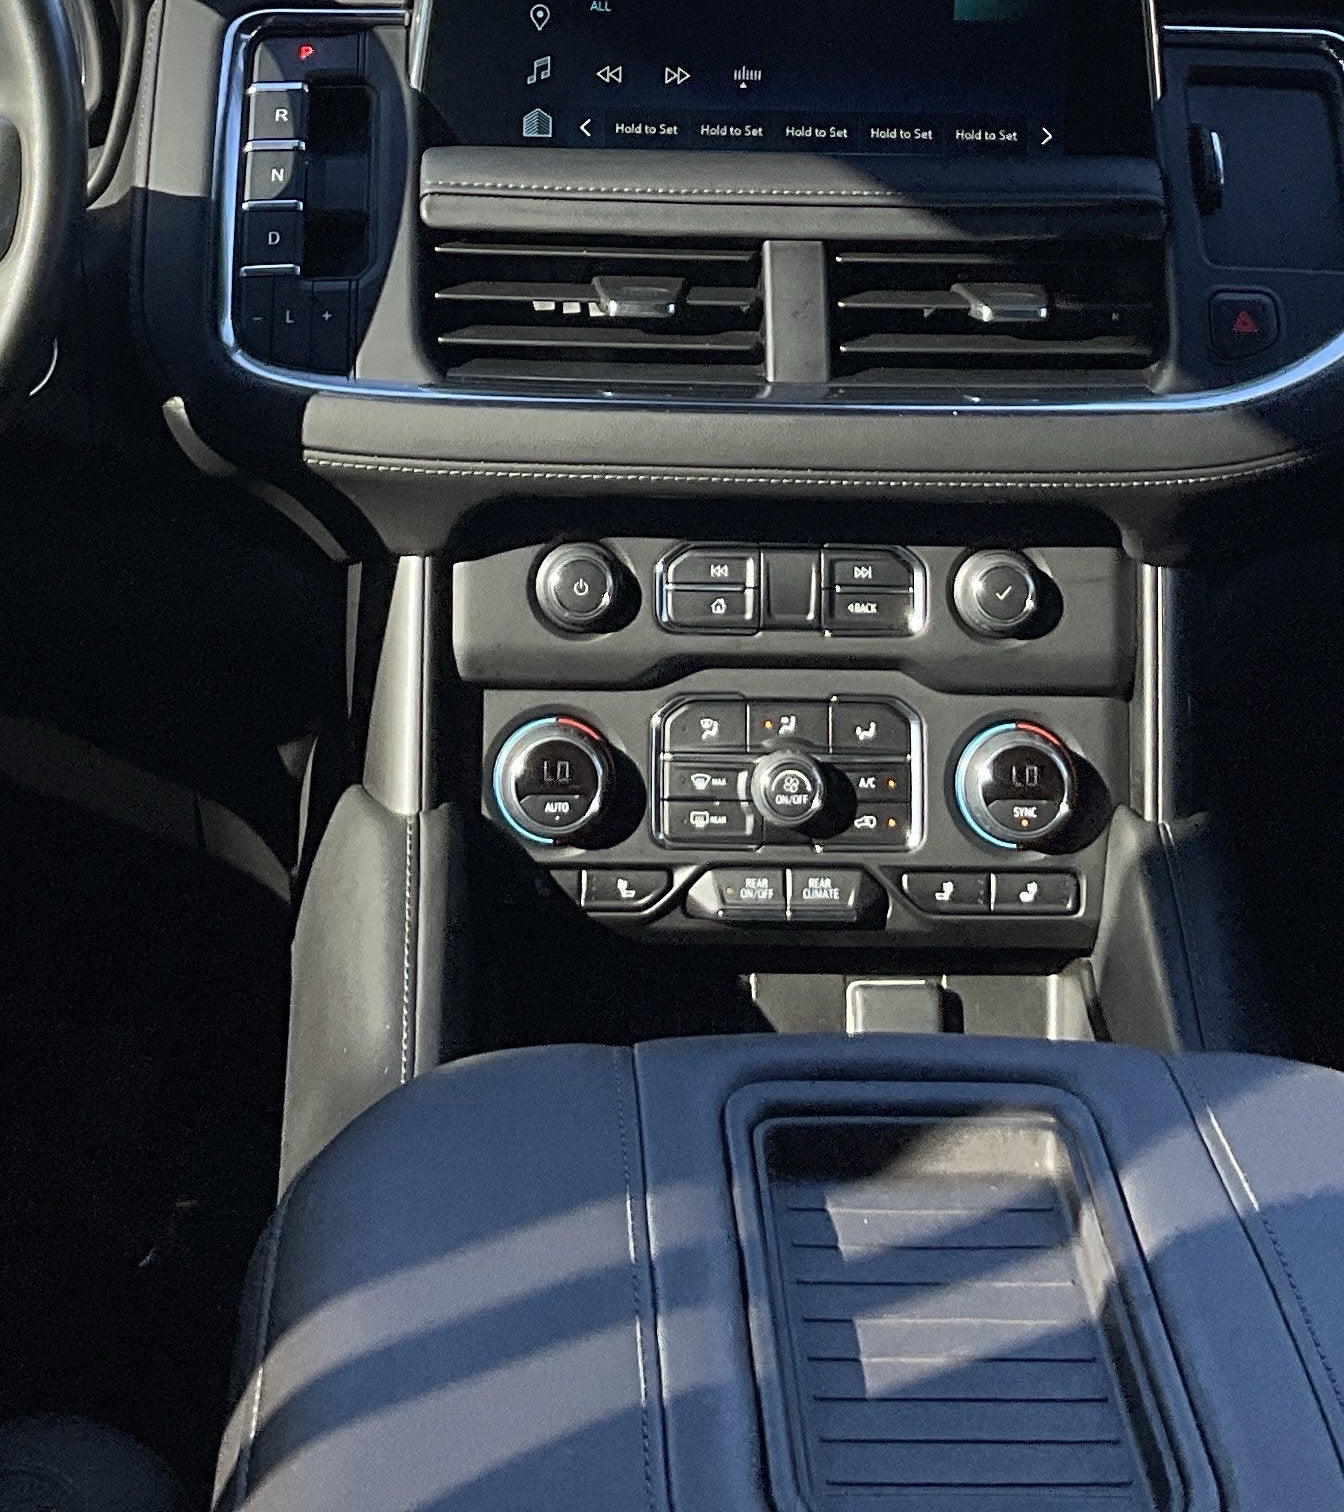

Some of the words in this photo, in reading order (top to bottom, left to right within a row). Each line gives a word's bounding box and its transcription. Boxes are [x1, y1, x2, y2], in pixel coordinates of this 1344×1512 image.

[589, 0, 612, 13] ALL
[297, 44, 314, 61] P
[274, 107, 289, 122] R
[615, 123, 642, 135] Hold
[644, 124, 657, 135] to
[659, 124, 679, 135] Set
[700, 124, 728, 136] Hold
[730, 125, 742, 136] to
[744, 125, 764, 136] Set
[785, 125, 812, 137] Hold
[815, 126, 827, 137] to
[829, 126, 848, 137] Set
[870, 127, 897, 139] Hold
[899, 128, 912, 139] to
[914, 128, 933, 139] Set
[955, 129, 981, 141] Hold
[984, 130, 996, 141] to
[998, 130, 1018, 141] Set
[270, 168, 285, 182] N
[267, 231, 281, 246] D
[285, 309, 295, 324] L
[854, 602, 877, 614] BACK
[858, 777, 876, 789] A/C
[775, 794, 809, 805] ON/OFF
[544, 801, 570, 813] AUTO
[1012, 806, 1038, 818] SYNC
[709, 816, 727, 825] REAR
[745, 877, 769, 889] REAR
[808, 877, 832, 889] REAR
[739, 888, 774, 900] ON/OFF
[802, 888, 840, 900] CLIMATE
